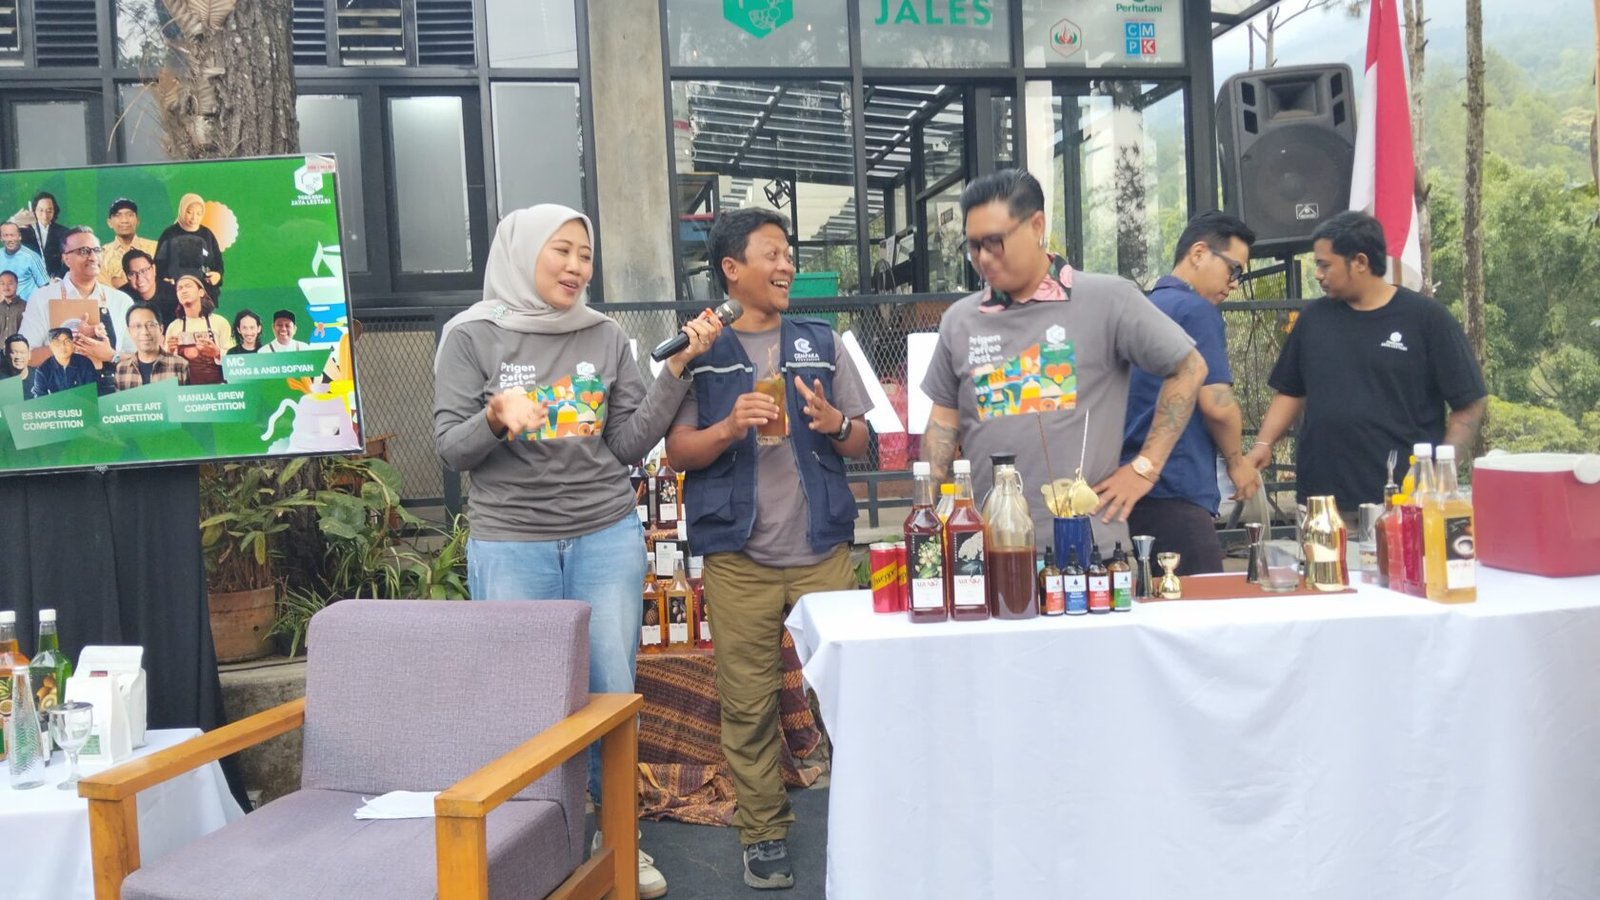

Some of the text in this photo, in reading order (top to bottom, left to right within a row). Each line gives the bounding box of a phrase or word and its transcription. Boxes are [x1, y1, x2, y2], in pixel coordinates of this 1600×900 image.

[875, 0, 991, 25] JALES
[1116, 3, 1162, 13] Perhutani
[226, 357, 245, 367] MC
[500, 361, 536, 374] Prigen
[228, 364, 314, 376] AANG & ANDI SOFYAN
[499, 373, 536, 382] Coffee
[178, 391, 244, 402] MANUAL BREW
[116, 402, 162, 413] LATTE ART
[184, 401, 246, 413] COMPETITION
[21, 409, 82, 420] ES KOPI SUSU
[102, 413, 164, 424] COMPETITION
[22, 419, 84, 431] COMPETITION
